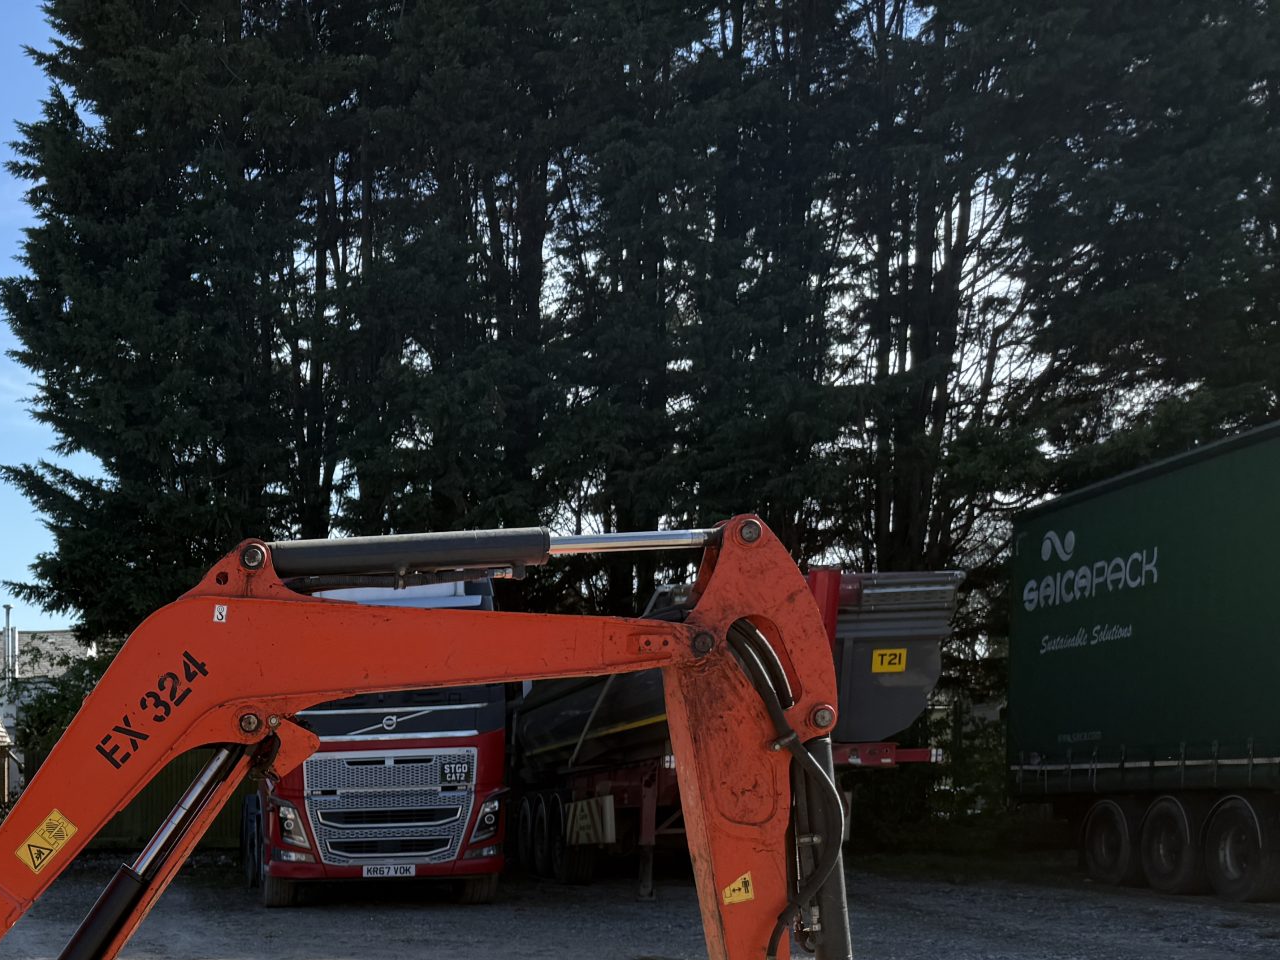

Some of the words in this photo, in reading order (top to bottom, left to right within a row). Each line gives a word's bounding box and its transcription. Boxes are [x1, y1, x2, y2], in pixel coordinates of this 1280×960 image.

[1040, 626, 1088, 655] Sustainable
[1090, 624, 1133, 645] Solutions
[878, 653, 902, 666] T21
[96, 714, 150, 770] EX
[140, 650, 209, 722] 324
[444, 764, 468, 773] STGO
[446, 773, 466, 781] CAT2
[366, 866, 391, 876] KR67
[393, 866, 412, 875] VOK
